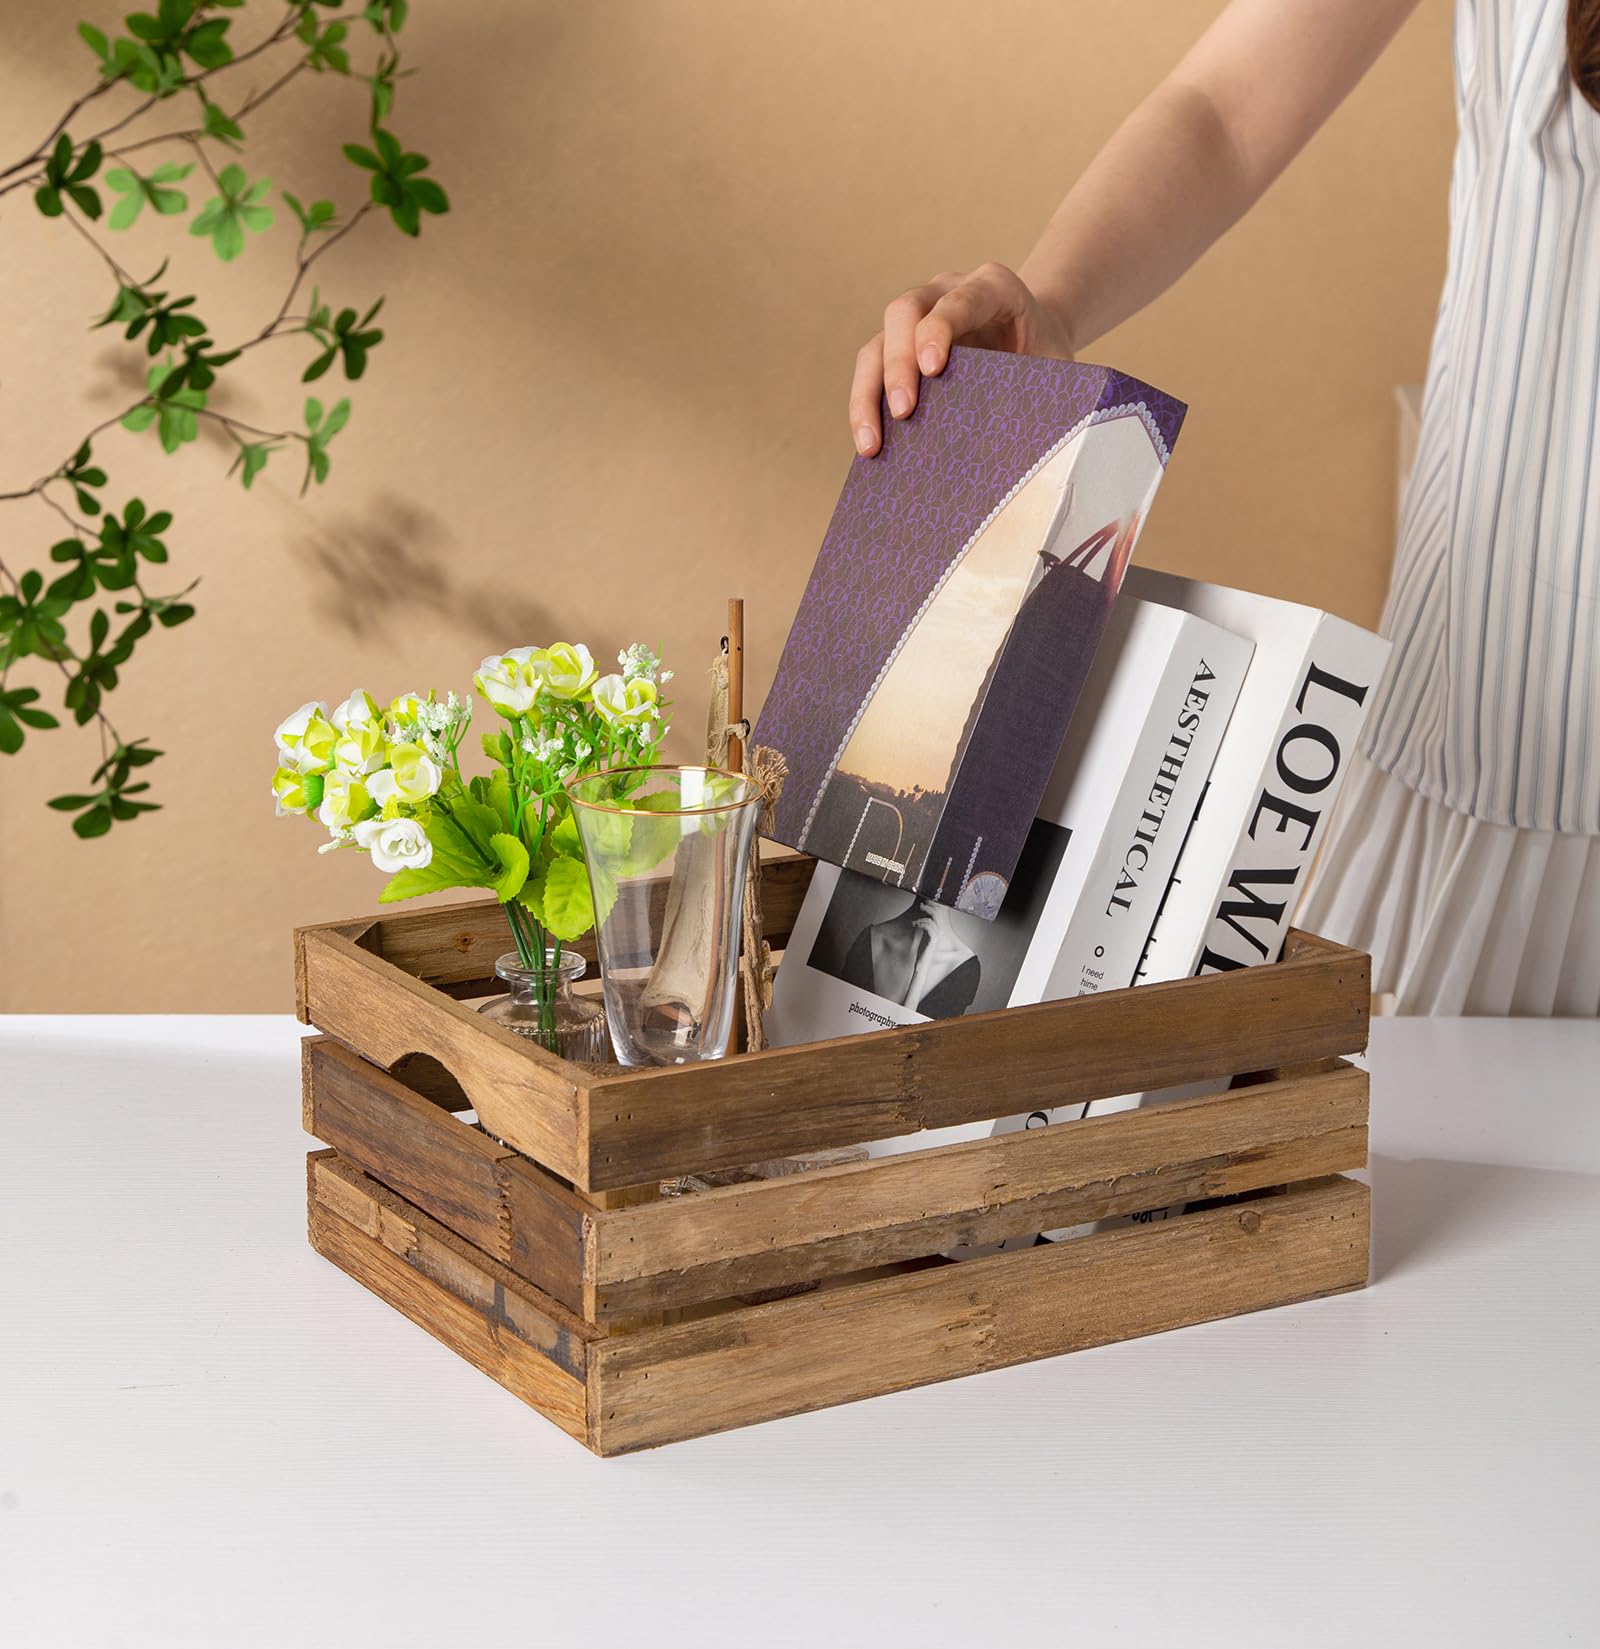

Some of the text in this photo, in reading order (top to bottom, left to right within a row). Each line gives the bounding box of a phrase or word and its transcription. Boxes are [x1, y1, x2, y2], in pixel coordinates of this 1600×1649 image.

[1106, 658, 1216, 918] AESTHETICAL
[1086, 968, 1105, 980] need
[848, 1002, 896, 1029] photography
